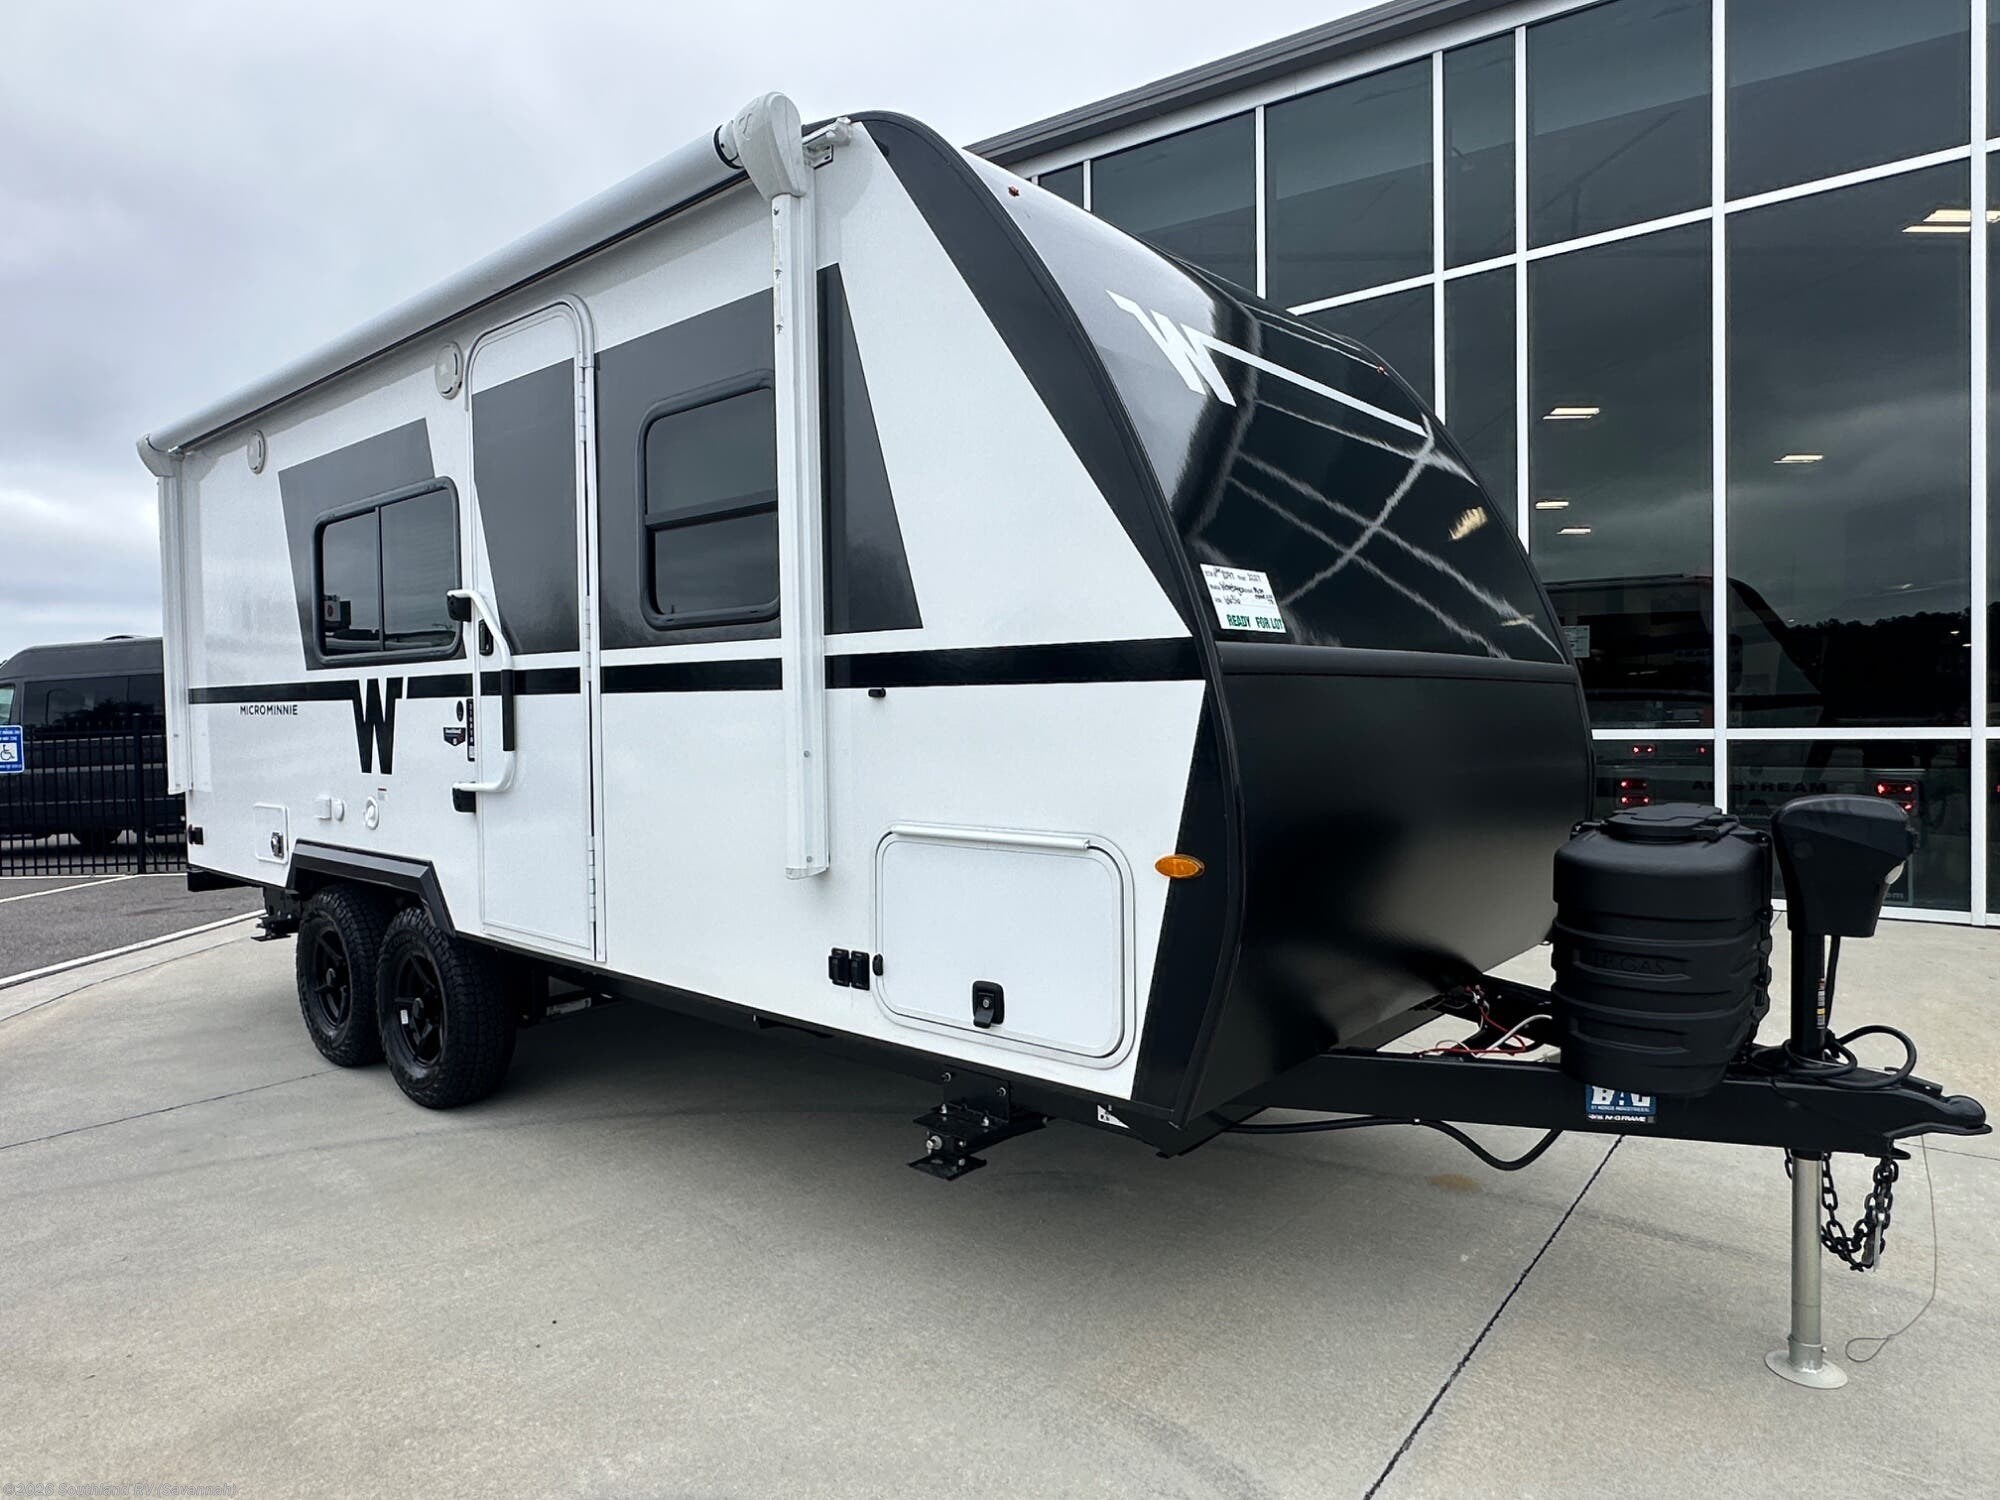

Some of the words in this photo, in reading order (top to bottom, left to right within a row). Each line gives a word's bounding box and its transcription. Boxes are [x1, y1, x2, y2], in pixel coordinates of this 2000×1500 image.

[1226, 614, 1251, 628] READY
[1255, 616, 1271, 629] FOR
[1270, 617, 1284, 630] LOT
[239, 704, 298, 716] MICROMINNIE
[352, 676, 404, 775] W
[1692, 781, 1827, 793] AISTREAM
